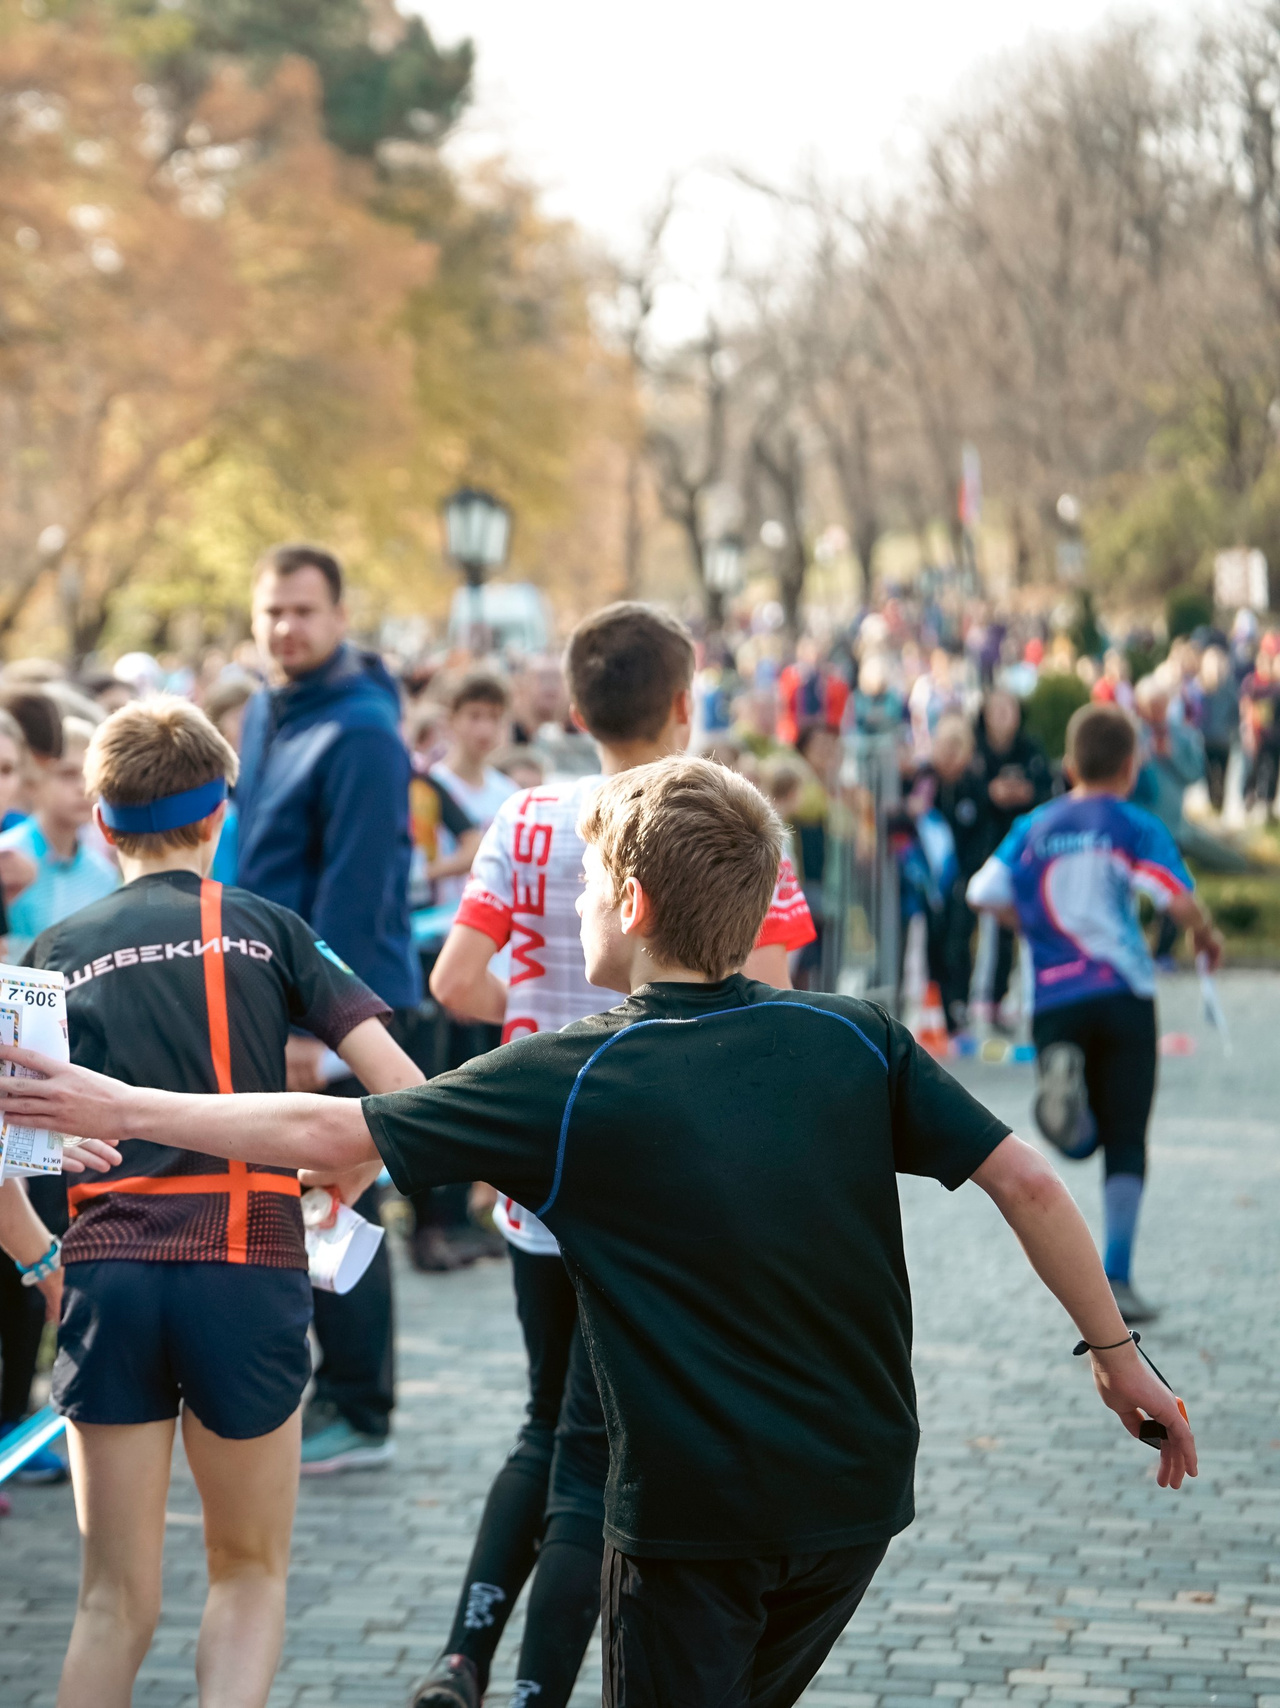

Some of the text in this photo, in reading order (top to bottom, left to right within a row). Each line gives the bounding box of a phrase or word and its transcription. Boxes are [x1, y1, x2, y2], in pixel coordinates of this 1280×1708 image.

[510, 786, 561, 987] WEST
[64, 935, 274, 992] ШЕБЕКИНО
[8, 987, 58, 1008] 309.2
